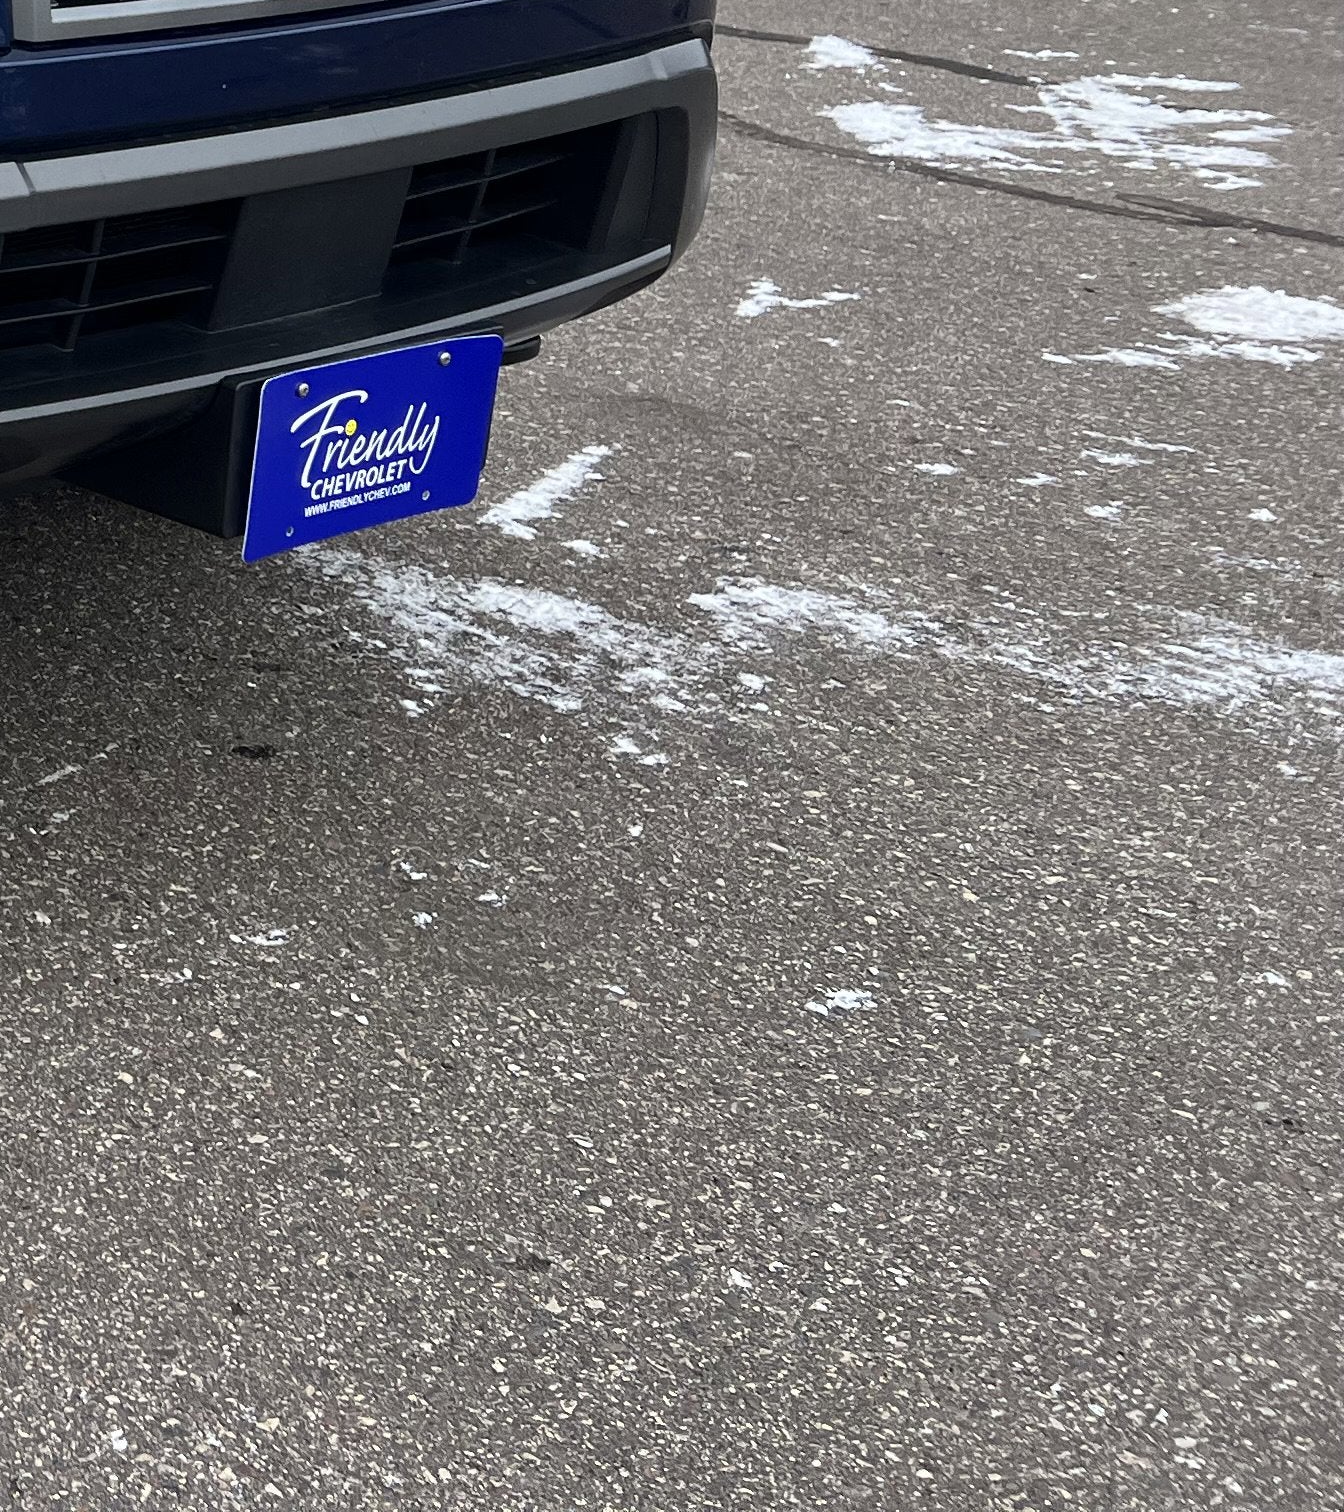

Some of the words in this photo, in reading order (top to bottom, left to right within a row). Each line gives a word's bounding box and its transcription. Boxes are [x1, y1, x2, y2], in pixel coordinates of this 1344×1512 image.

[290, 390, 440, 489] Friendly
[303, 481, 412, 518] WWW.FRIENDLYCHEV.COM
[310, 458, 408, 501] CHEVROLET
